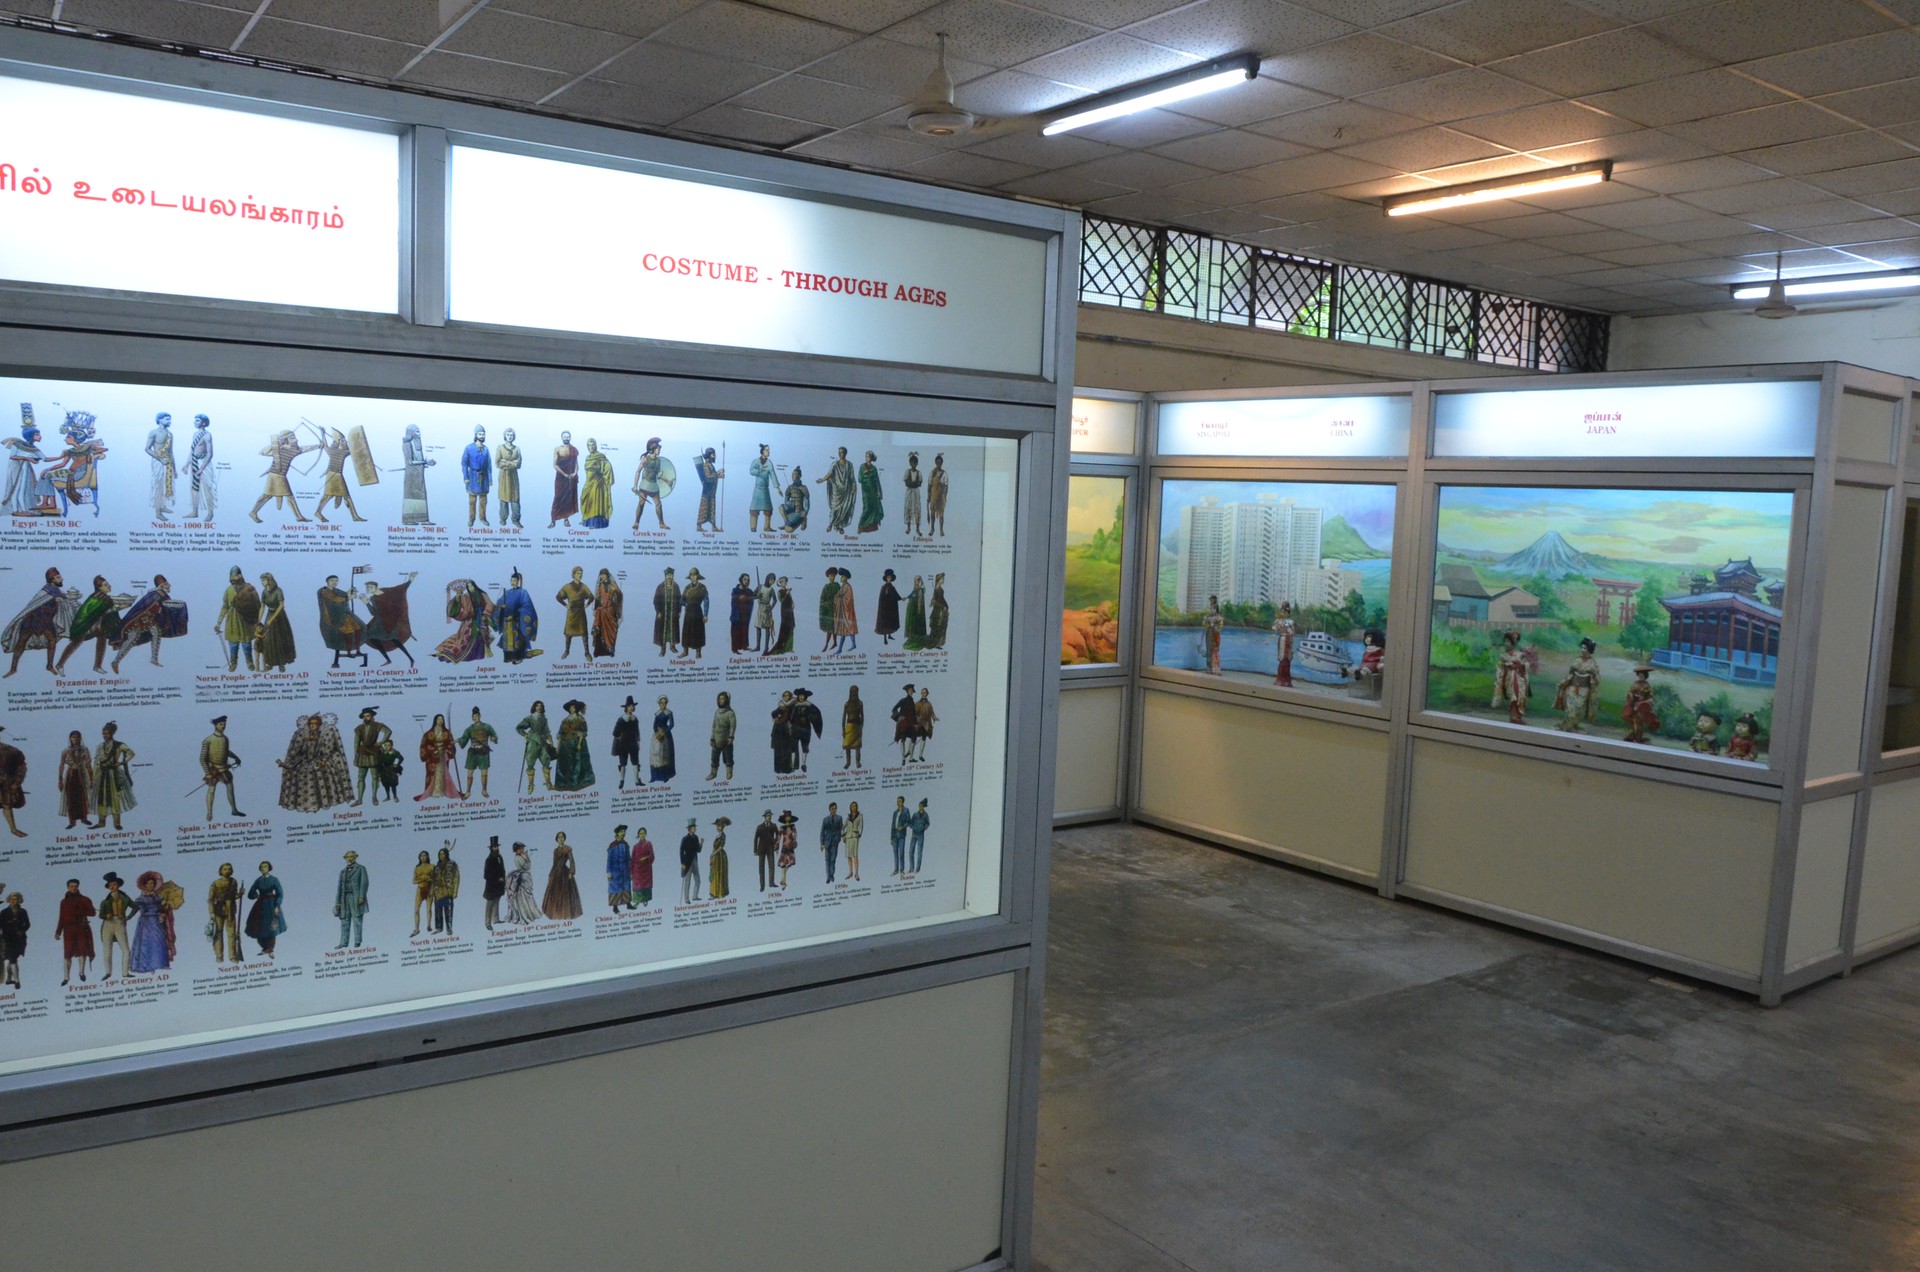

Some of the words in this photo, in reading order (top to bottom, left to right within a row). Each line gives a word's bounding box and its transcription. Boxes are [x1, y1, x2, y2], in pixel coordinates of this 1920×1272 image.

[73, 180, 344, 229] உடையலங்காரம்
[642, 253, 759, 284] COSTUME
[781, 270, 888, 299] THROUGH
[894, 284, 948, 308] AGES
[1197, 430, 1231, 438] SINGAPORE
[1330, 429, 1354, 437] CHINA
[1587, 425, 1617, 435] JAPAN
[12, 520, 38, 530] Egypt
[47, 520, 66, 528] 1350
[68, 520, 81, 528] BC
[151, 521, 176, 530] Nubia
[184, 522, 202, 530] 1000
[204, 522, 216, 530] BC
[281, 523, 309, 534] Assyria
[316, 524, 329, 532] 700
[331, 524, 343, 532] BC
[388, 525, 416, 536] Babylon
[423, 526, 435, 534] 700
[436, 526, 447, 534] BC
[469, 527, 494, 535] Parthia
[499, 528, 511, 536] 500
[512, 528, 522, 536] BC
[633, 530, 651, 538] Greek
[552, 662, 578, 671] Norman
[595, 661, 620, 672] Century
[621, 661, 631, 669] AD
[669, 658, 696, 668] Mongolia
[327, 670, 357, 678] Norman
[376, 668, 405, 679] Century
[407, 668, 419, 676] AD
[476, 665, 496, 675] Japan
[56, 678, 98, 689] Byzantine
[100, 678, 130, 688] Empire
[196, 674, 219, 683] Norse
[220, 674, 246, 684] People
[263, 672, 294, 683] Century
[297, 672, 309, 680] AD
[620, 786, 649, 796] American
[650, 785, 671, 794] Puritan
[519, 795, 545, 806] England
[562, 792, 587, 802] Century
[589, 791, 599, 800] AD
[420, 804, 441, 814] Japan
[460, 800, 487, 810] Century
[488, 799, 500, 808] AD
[333, 811, 363, 821] England
[178, 824, 201, 834] Spain
[223, 820, 255, 830] Century
[257, 819, 269, 827] AD
[56, 835, 78, 844] India
[102, 830, 135, 841] Century
[138, 829, 152, 838] AD
[674, 901, 710, 913] International
[595, 914, 613, 924] China
[628, 909, 652, 920] Century
[653, 908, 663, 917] AD
[491, 927, 518, 939] England
[536, 922, 561, 933] Century
[562, 921, 573, 930] AD
[410, 938, 430, 947] North
[432, 935, 460, 946] America
[325, 949, 346, 959] North
[348, 946, 377, 957] America
[218, 964, 240, 973] North
[242, 961, 273, 971] America
[69, 982, 98, 993] France
[121, 976, 153, 987] Century
[156, 974, 169, 983] AD
[0, 992, 16, 1001] and
